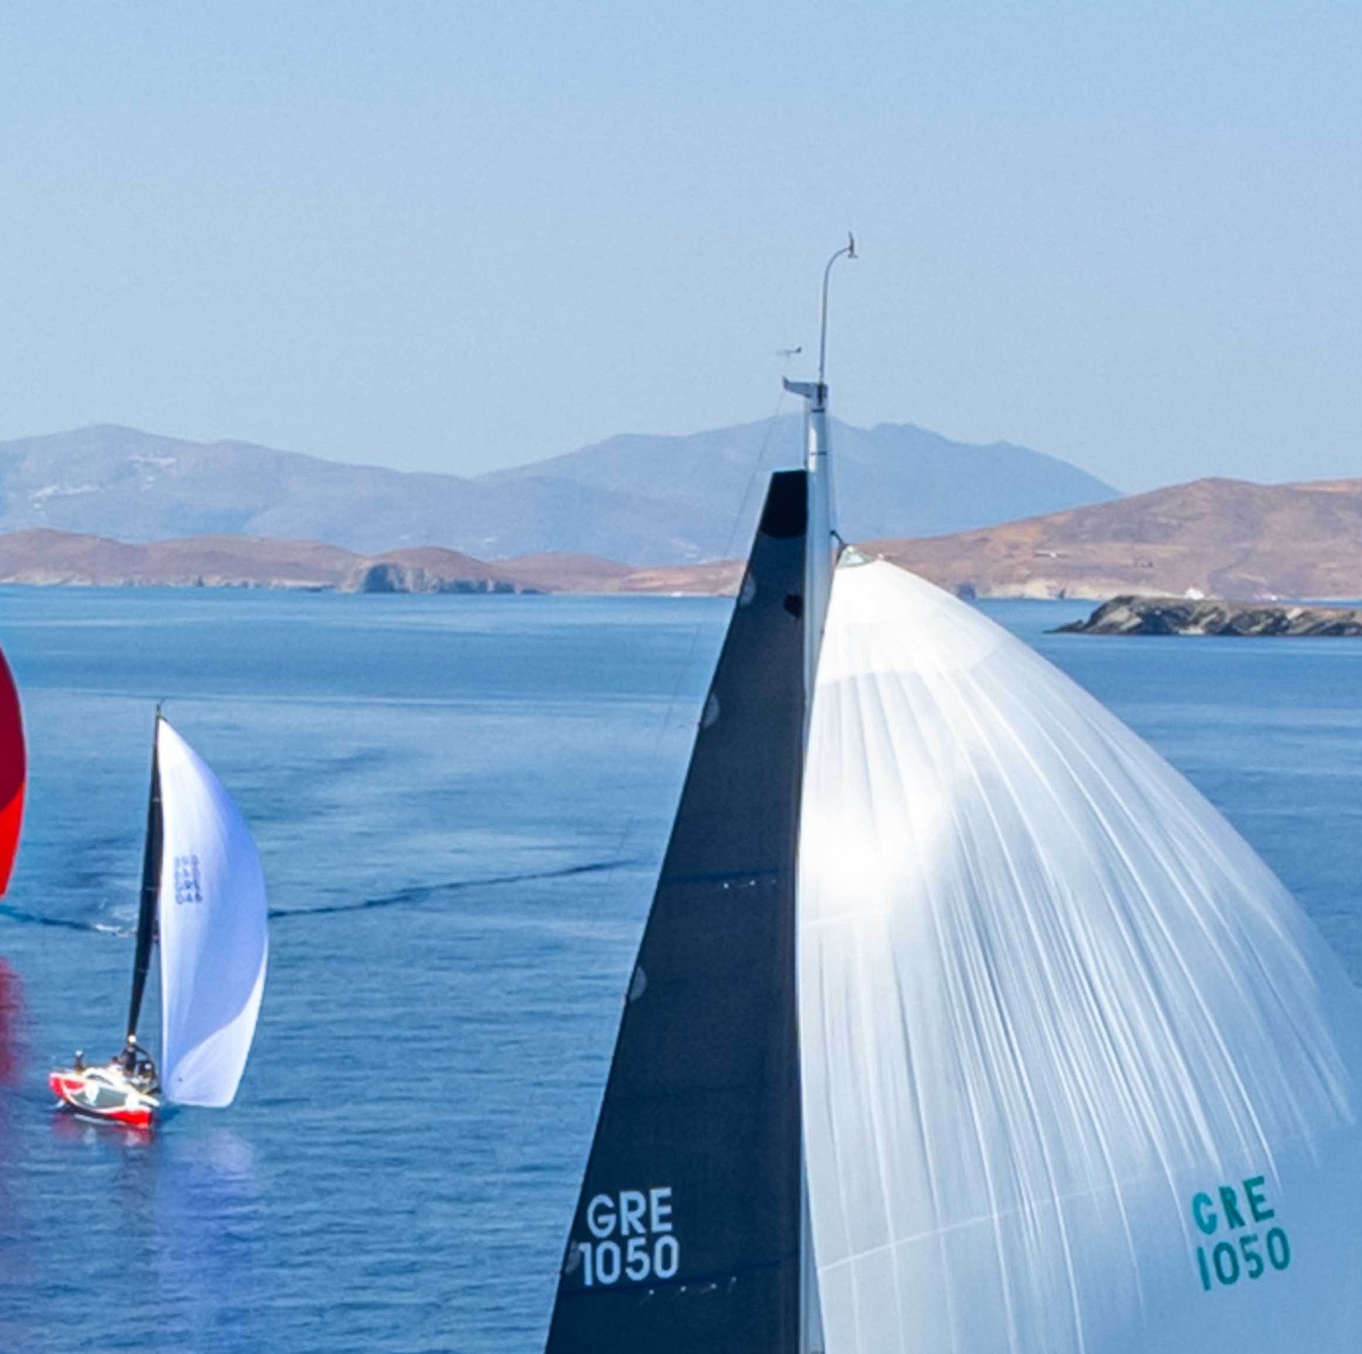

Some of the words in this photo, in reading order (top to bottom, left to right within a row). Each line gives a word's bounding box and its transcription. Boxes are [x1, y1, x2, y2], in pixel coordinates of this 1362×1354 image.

[587, 1187, 672, 1238] GRE
[1192, 1175, 1275, 1235] GRE
[578, 1235, 679, 1287] 1050
[1197, 1227, 1291, 1291] 1050
